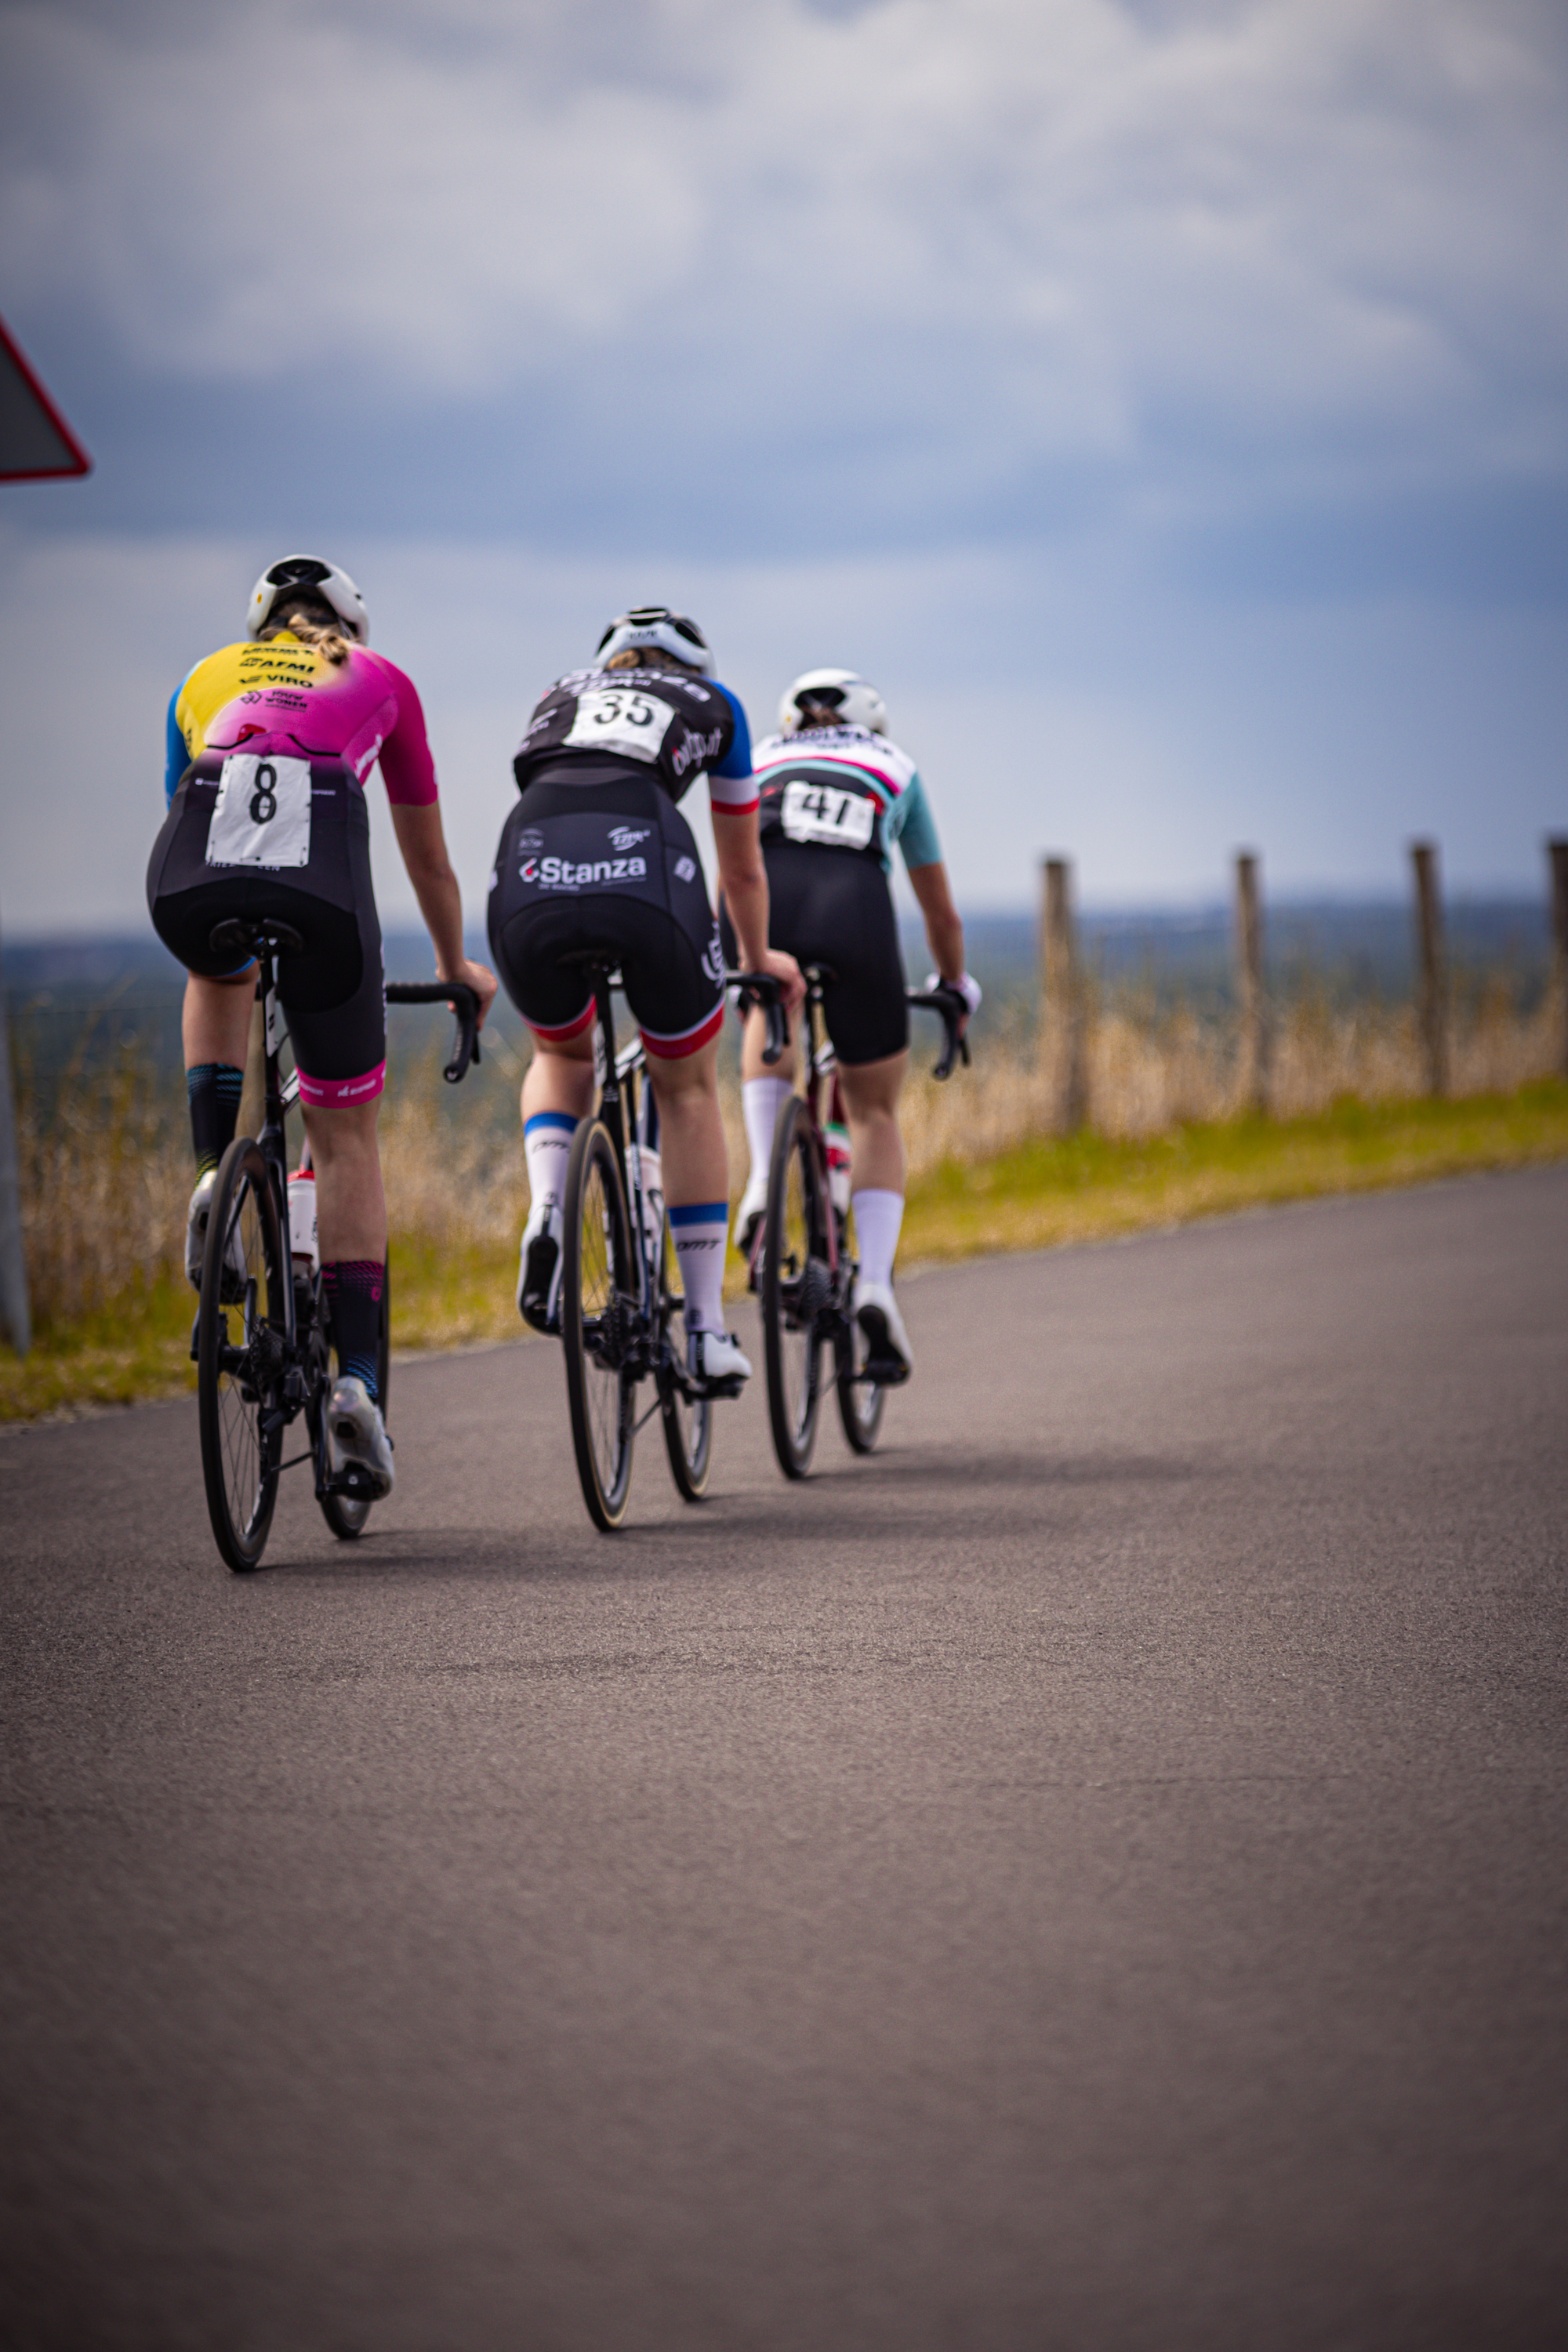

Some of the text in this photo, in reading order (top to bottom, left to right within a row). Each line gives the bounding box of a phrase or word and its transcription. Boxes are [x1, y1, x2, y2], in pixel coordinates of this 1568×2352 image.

[267, 675, 314, 688] VIRO
[265, 697, 308, 709] WONEN
[593, 694, 655, 726] 35
[249, 763, 278, 826] 8
[539, 856, 648, 884] Stanza
